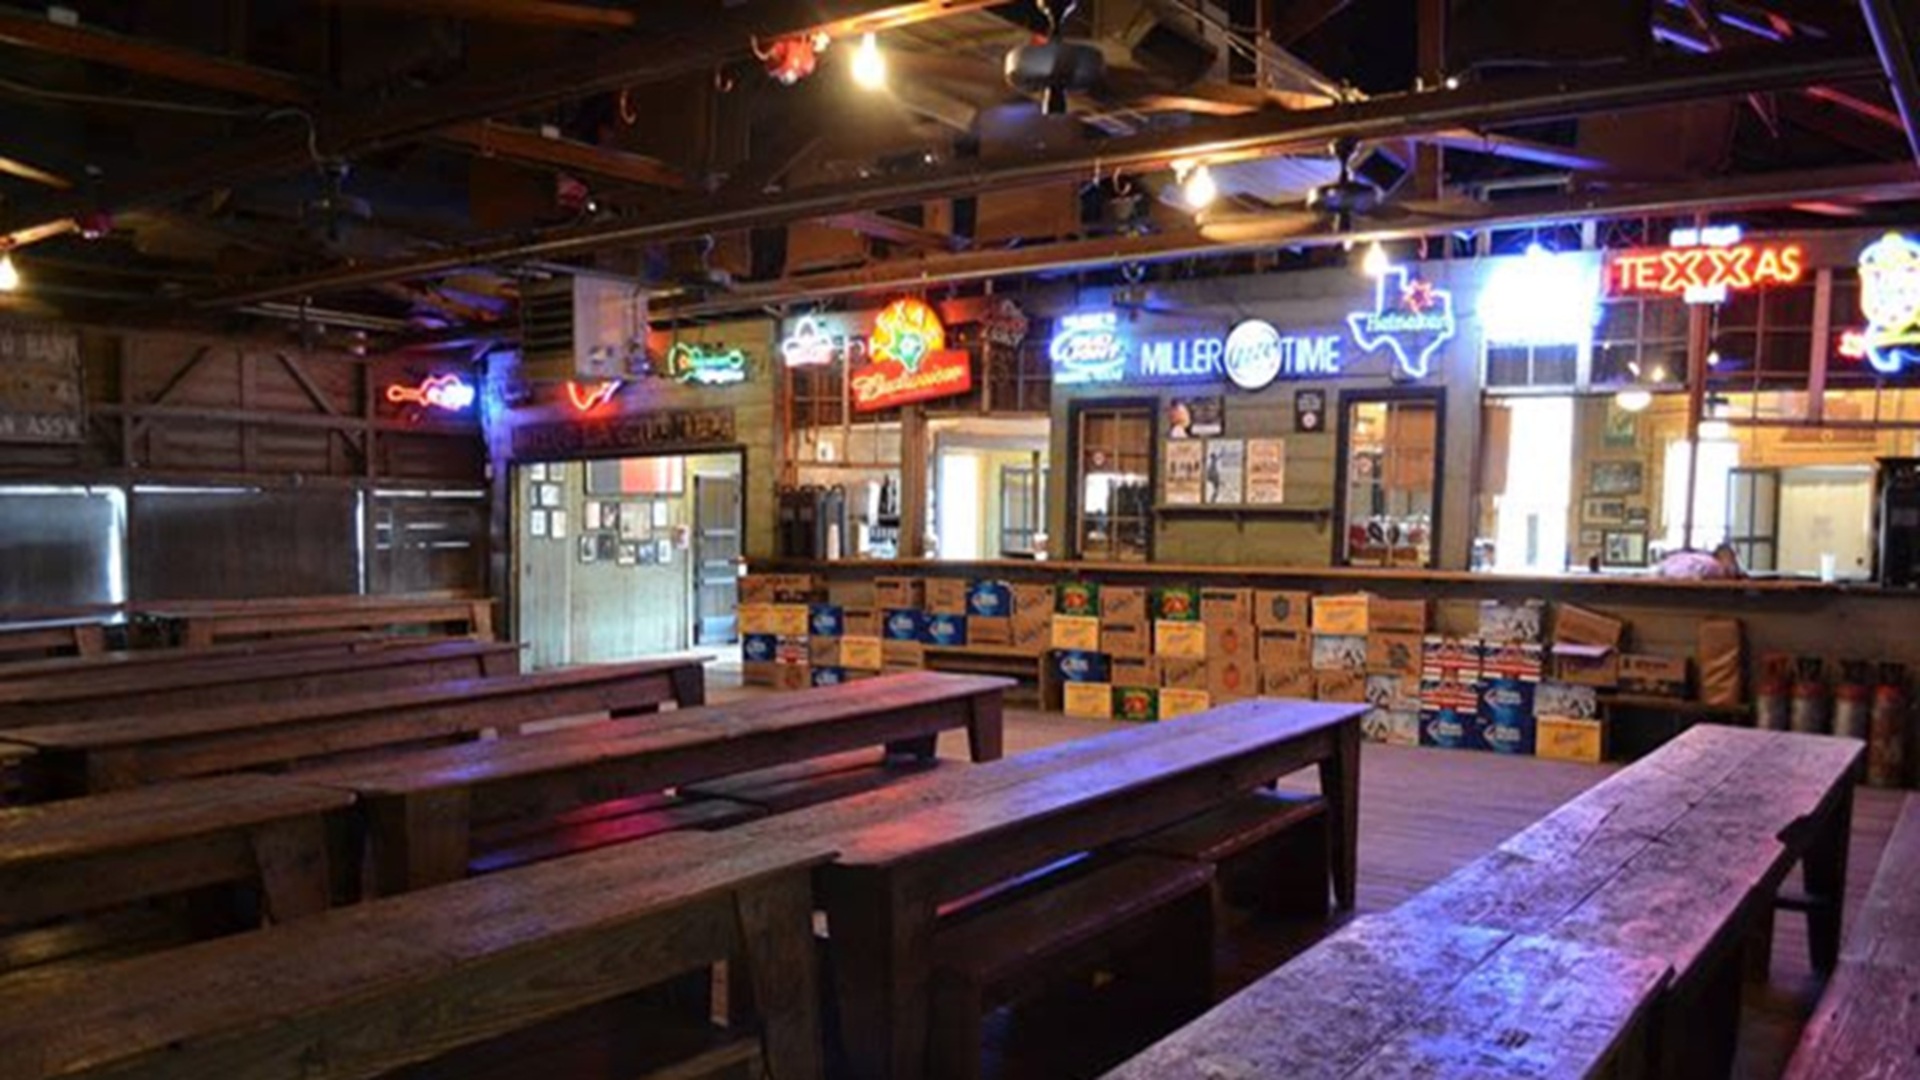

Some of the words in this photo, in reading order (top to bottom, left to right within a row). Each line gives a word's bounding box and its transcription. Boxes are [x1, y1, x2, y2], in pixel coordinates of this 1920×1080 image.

[1614, 246, 1802, 291] TEXXAS
[1140, 338, 1223, 376] MILLER
[1281, 335, 1341, 373] TIME
